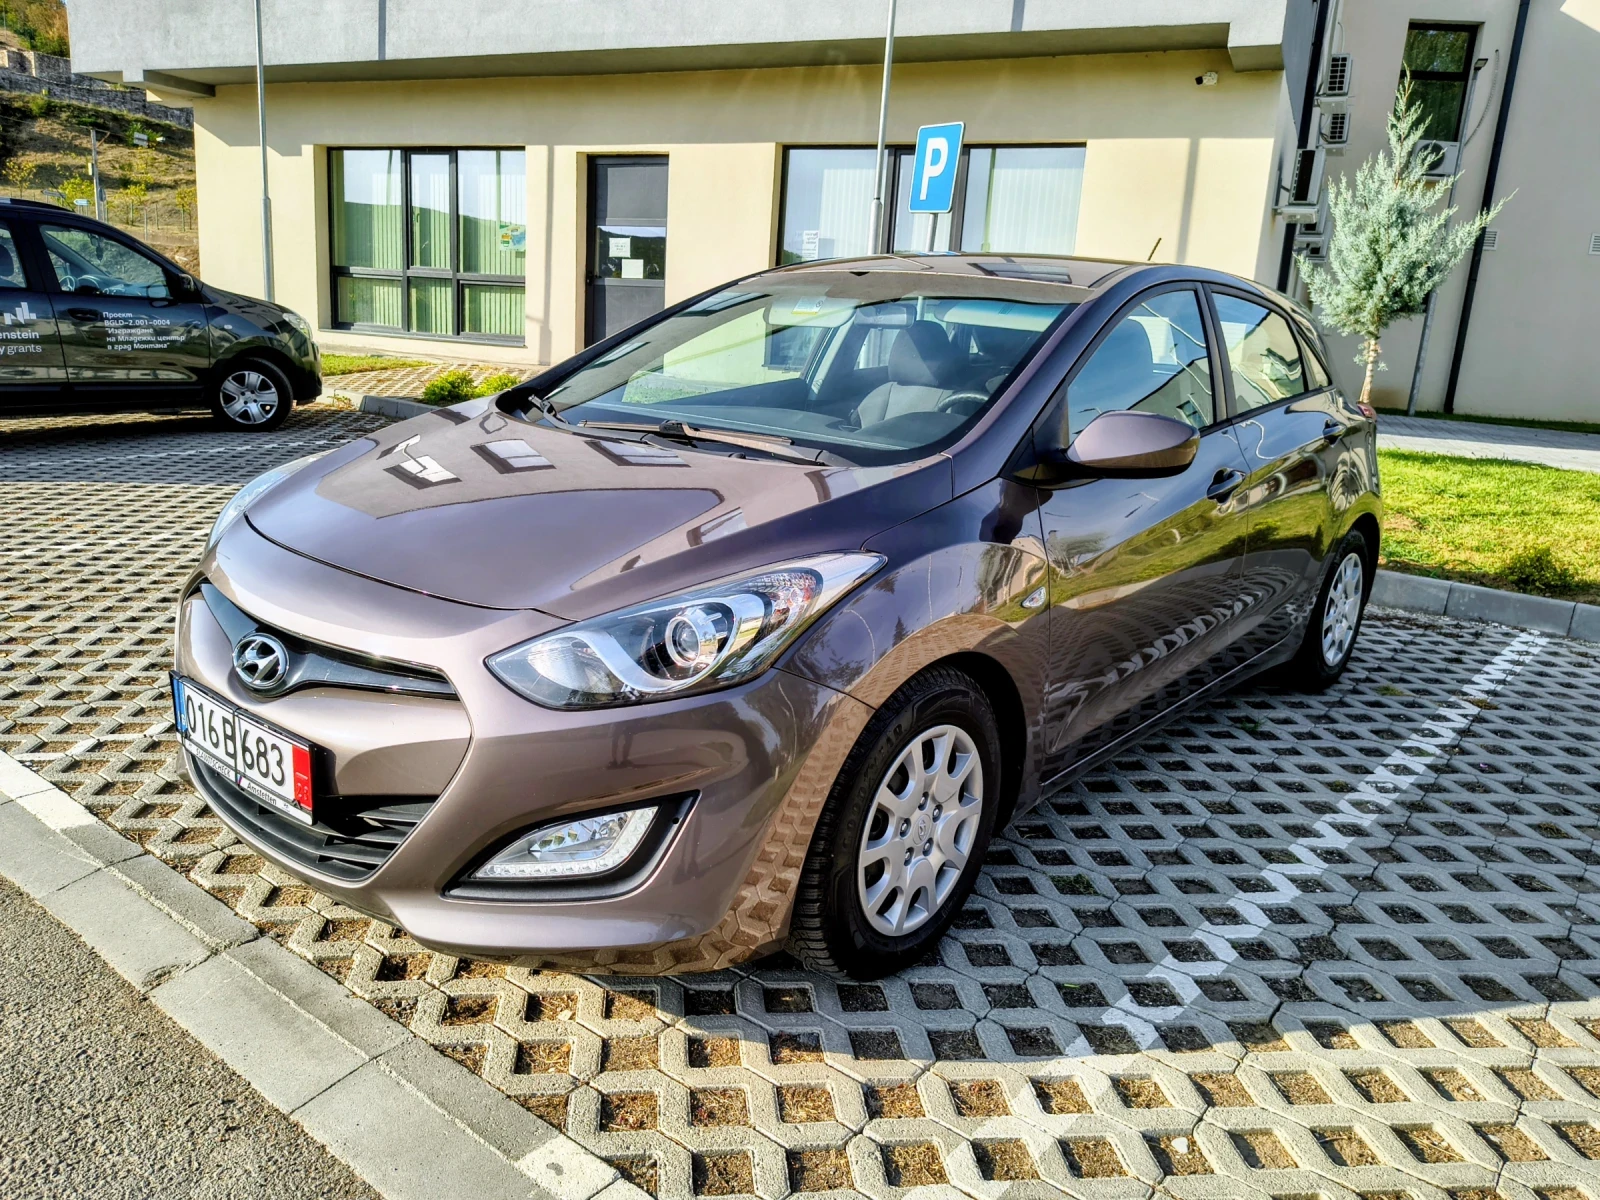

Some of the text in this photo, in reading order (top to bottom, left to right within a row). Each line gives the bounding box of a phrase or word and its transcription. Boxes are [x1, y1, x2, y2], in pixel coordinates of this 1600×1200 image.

[919, 137, 949, 201] P
[118, 335, 155, 343] Младежки
[7, 344, 42, 355] grants
[246, 782, 277, 806] Amstetten
